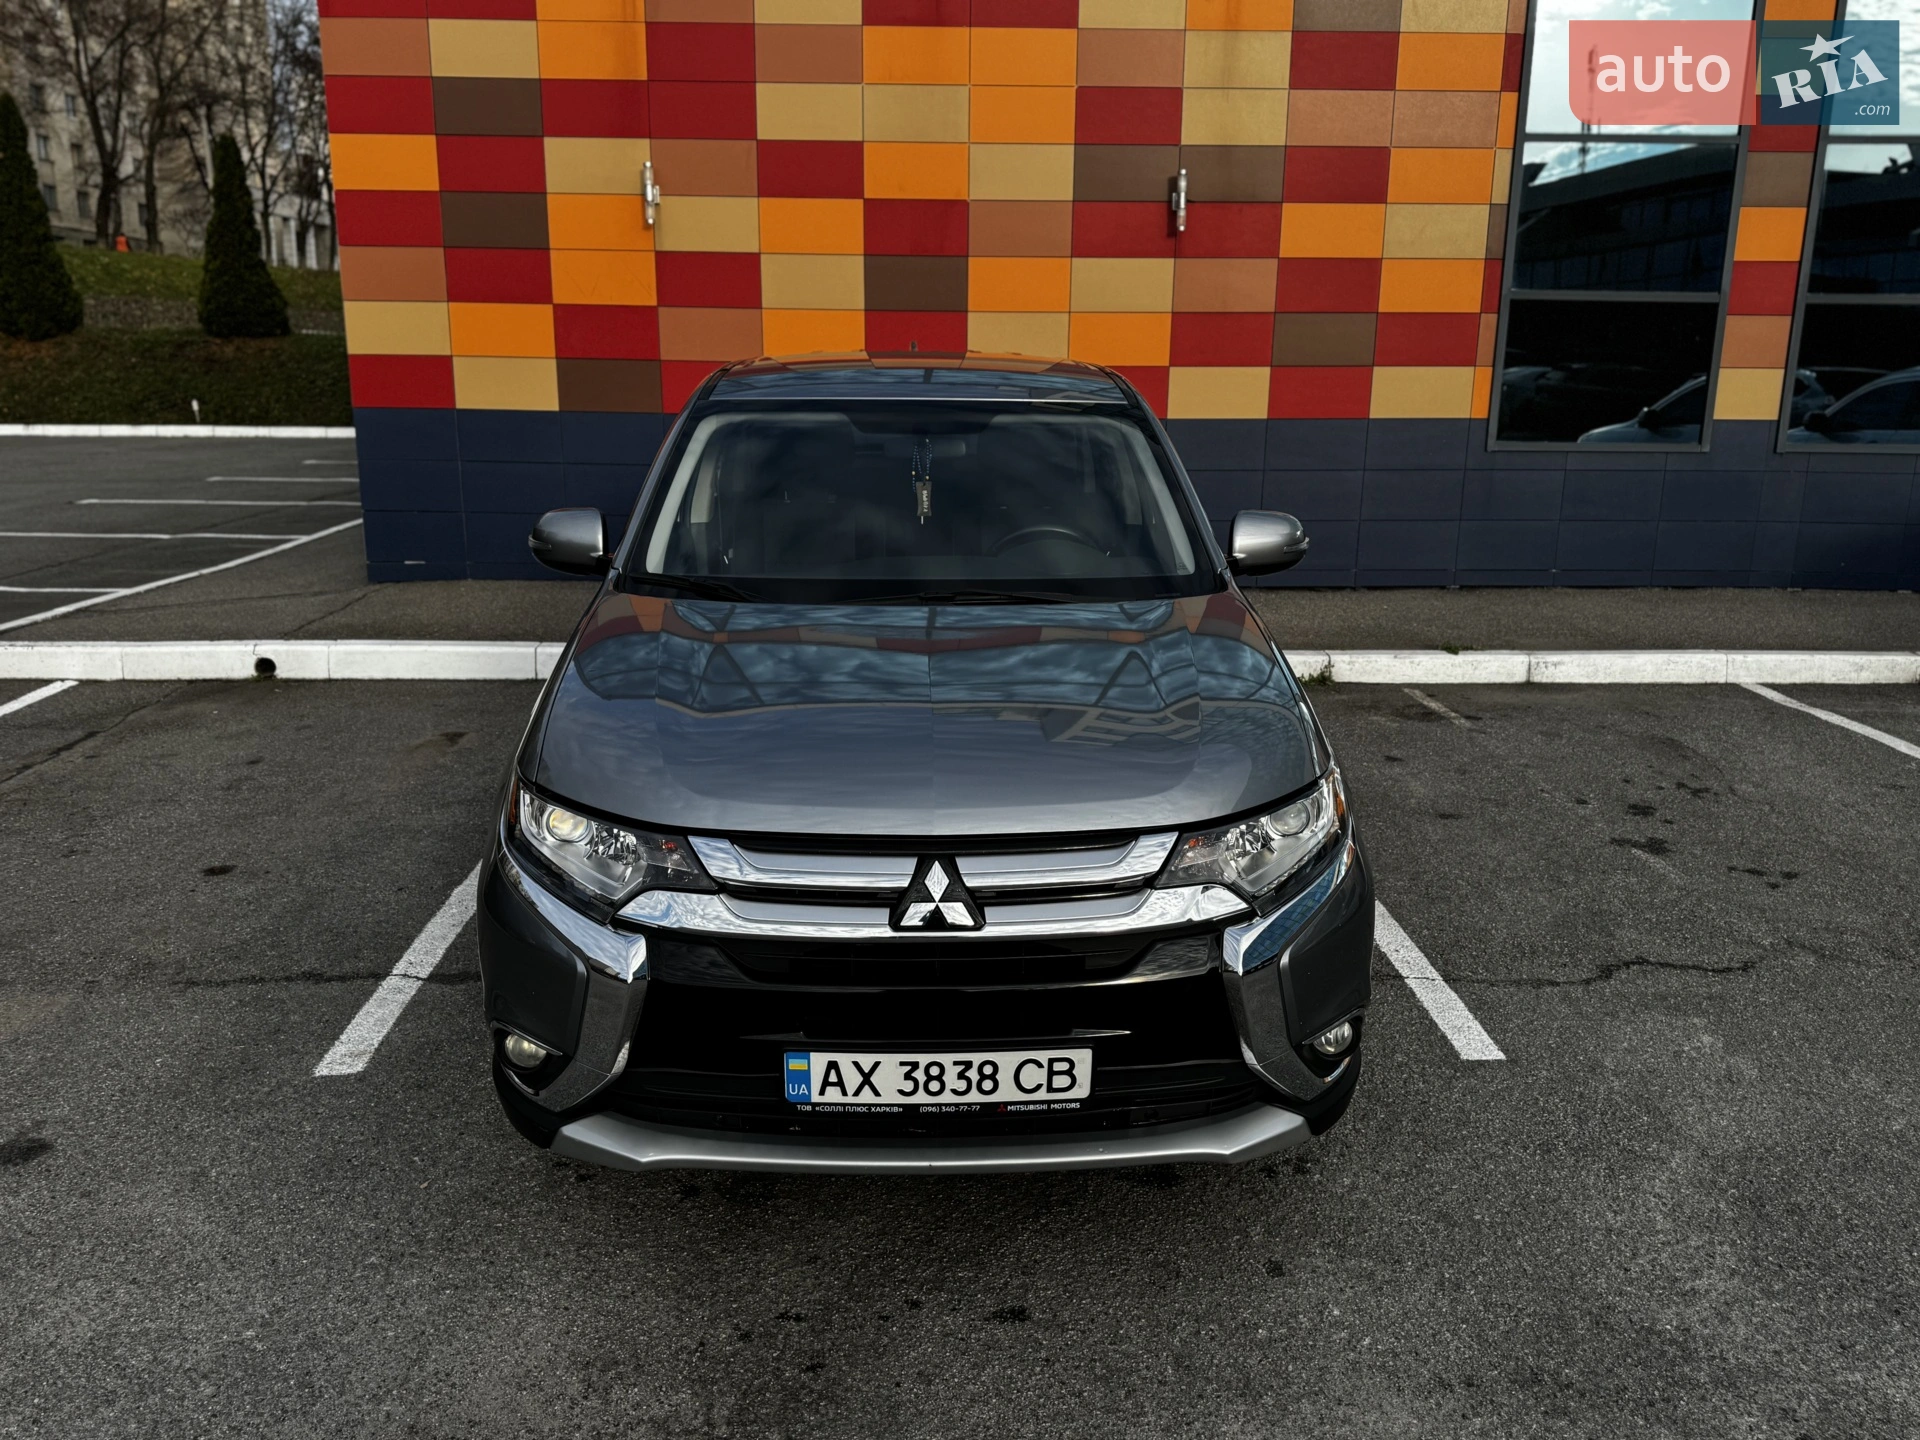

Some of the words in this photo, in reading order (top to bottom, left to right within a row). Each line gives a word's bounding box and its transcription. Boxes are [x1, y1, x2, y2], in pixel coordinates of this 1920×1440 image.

[818, 1060, 882, 1097] AX
[896, 1059, 1000, 1097] 3838
[1013, 1056, 1078, 1095] CB
[789, 1083, 809, 1095] UA
[1007, 1103, 1048, 1111] MITSUBISHI
[1050, 1102, 1081, 1110] MOTORS
